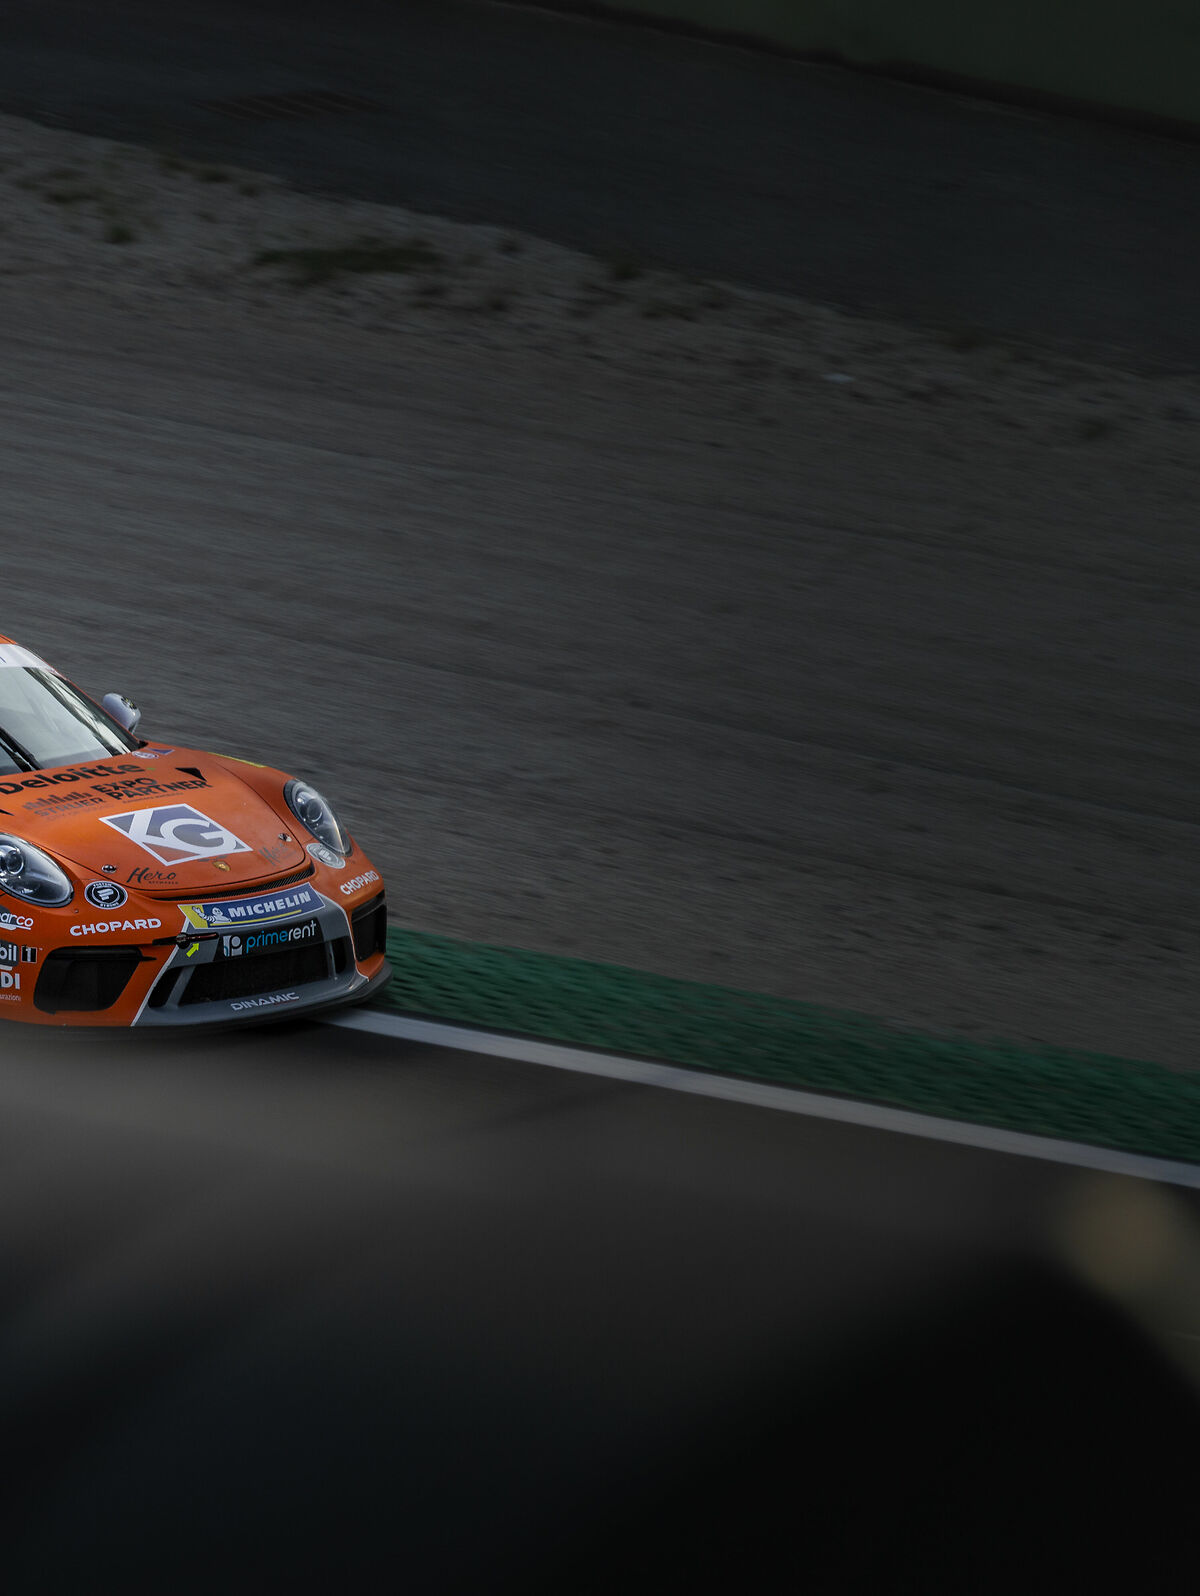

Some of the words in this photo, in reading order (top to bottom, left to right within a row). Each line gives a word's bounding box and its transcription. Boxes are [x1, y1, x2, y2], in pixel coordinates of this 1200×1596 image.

[91, 777, 158, 793] EXPO
[34, 797, 104, 817] STRUER
[106, 779, 211, 801] PARTNER
[126, 866, 177, 883] Hero
[339, 870, 380, 895] CHOPARD
[228, 891, 311, 918] MICHELIN
[69, 917, 162, 936] CHOPARD
[246, 920, 316, 953] primerent
[231, 991, 300, 1010] DINAMIC
